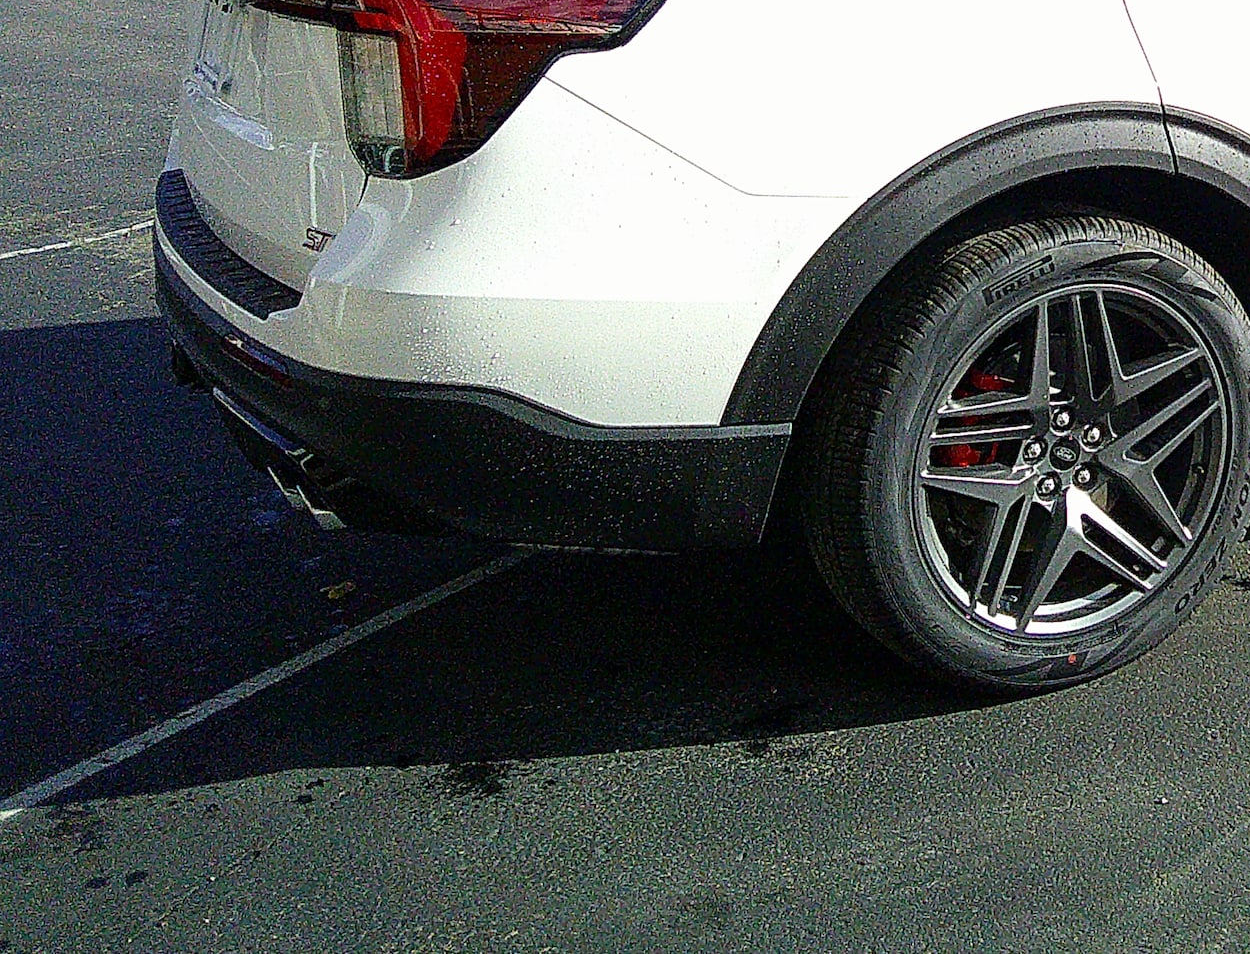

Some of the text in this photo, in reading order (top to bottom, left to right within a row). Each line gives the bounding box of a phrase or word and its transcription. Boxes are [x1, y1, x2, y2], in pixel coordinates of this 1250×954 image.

[302, 226, 337, 253] ST
[981, 254, 1055, 307] PIRELLI
[1174, 536, 1227, 614] ZERO
